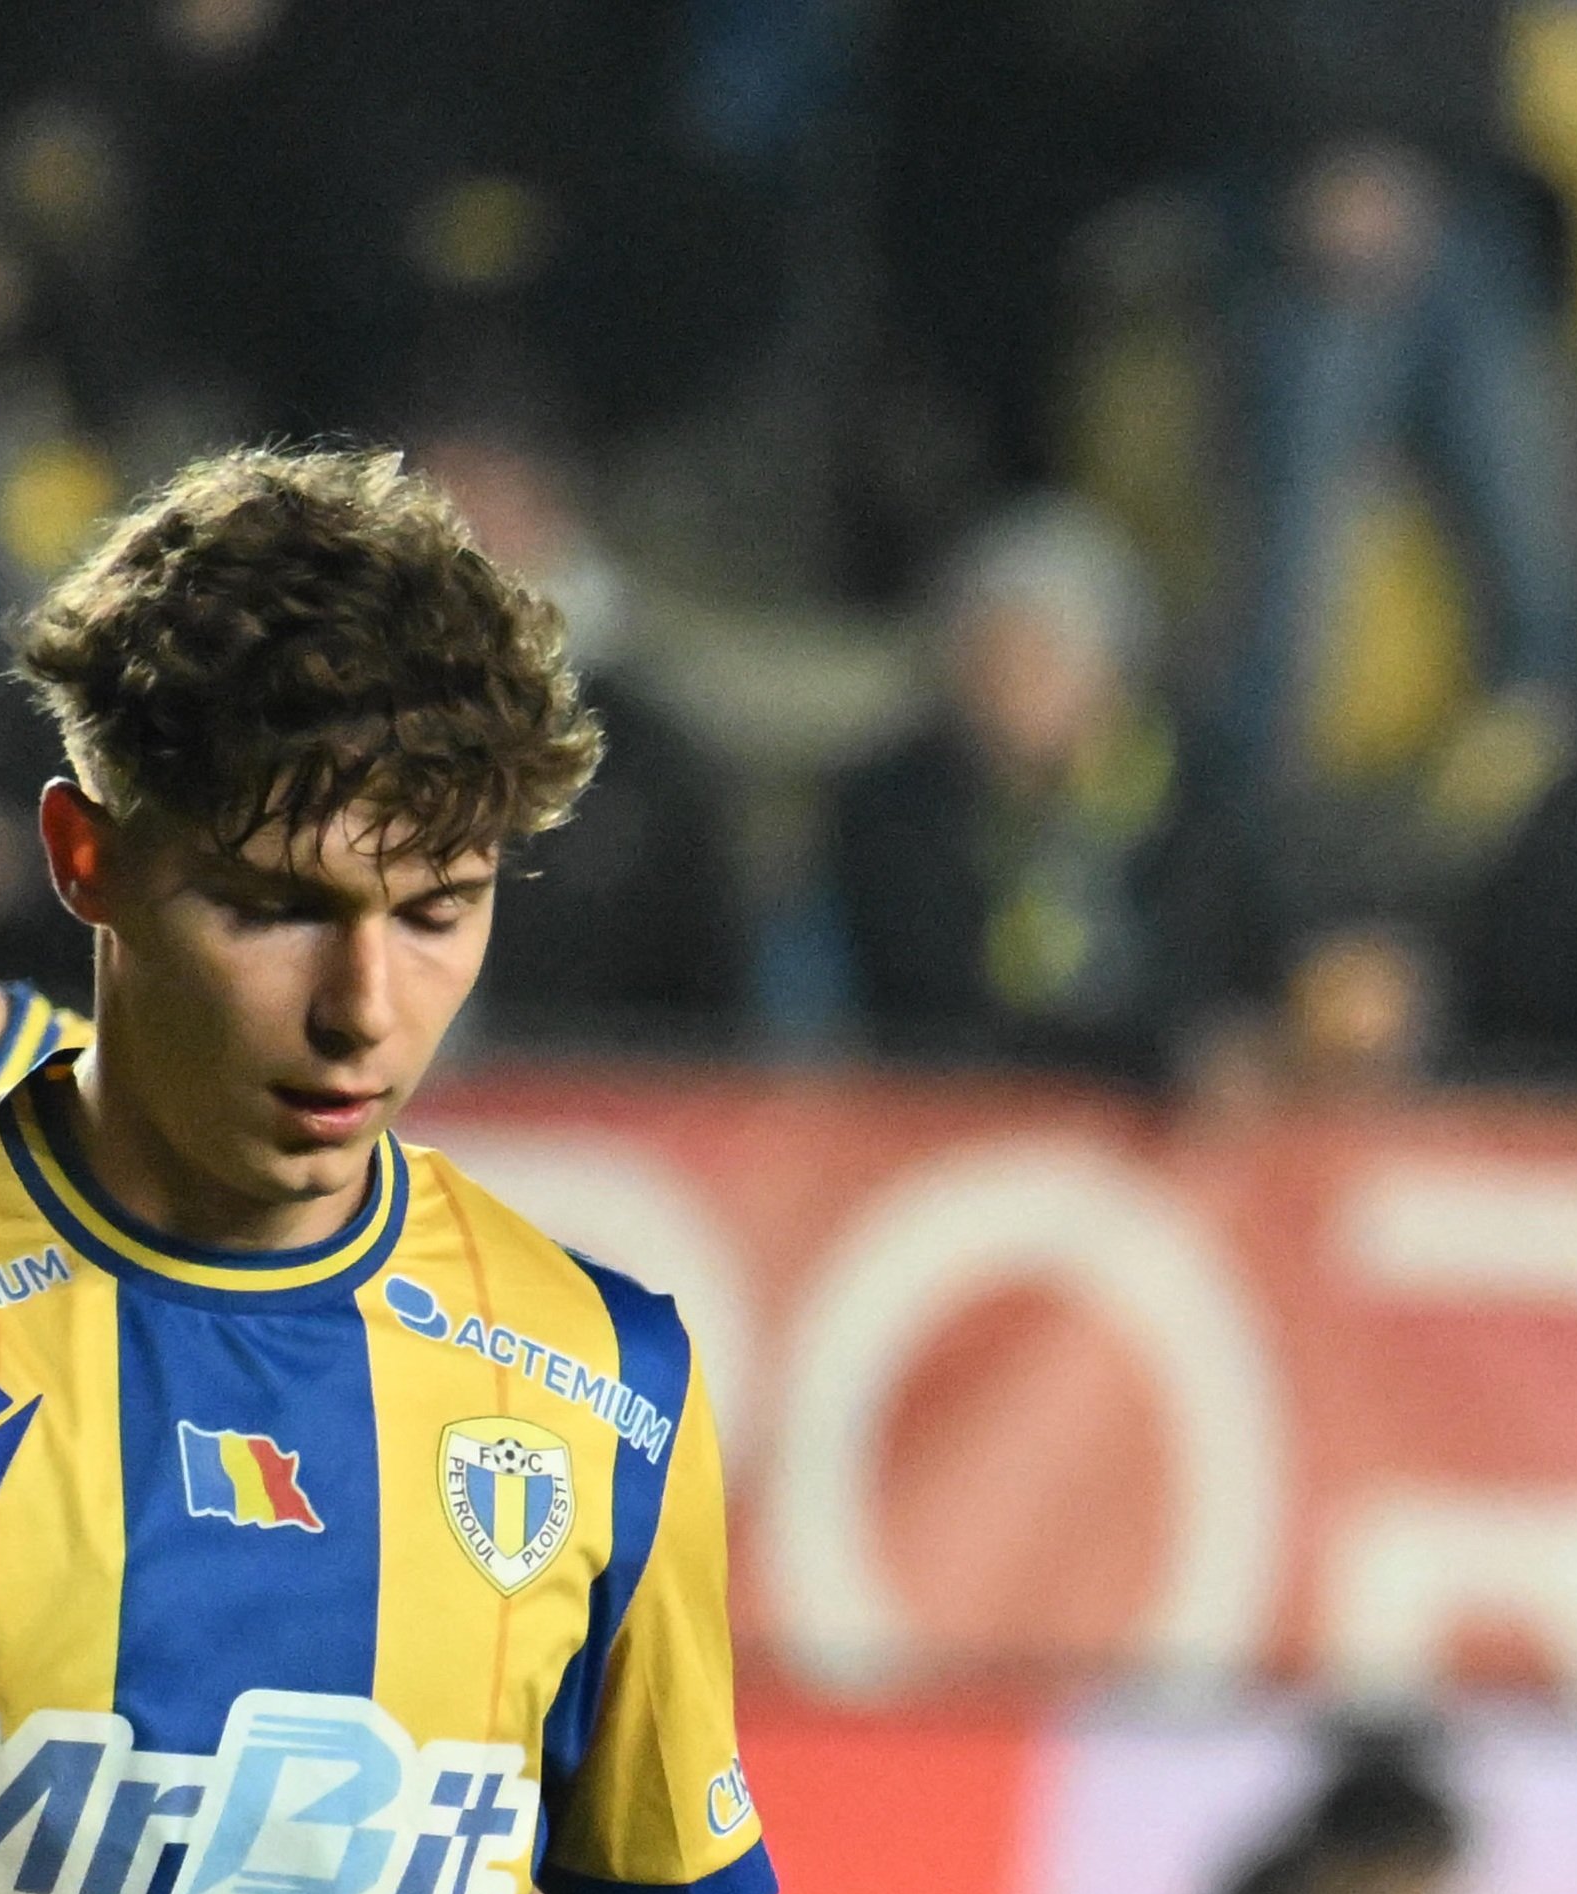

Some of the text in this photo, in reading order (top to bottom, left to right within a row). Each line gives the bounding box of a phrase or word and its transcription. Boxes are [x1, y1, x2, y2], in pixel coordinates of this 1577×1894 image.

[455, 1316, 671, 1463] ACTEMIUM
[448, 1456, 495, 1568] PETROLUL
[521, 1476, 568, 1569] PLOIESTI
